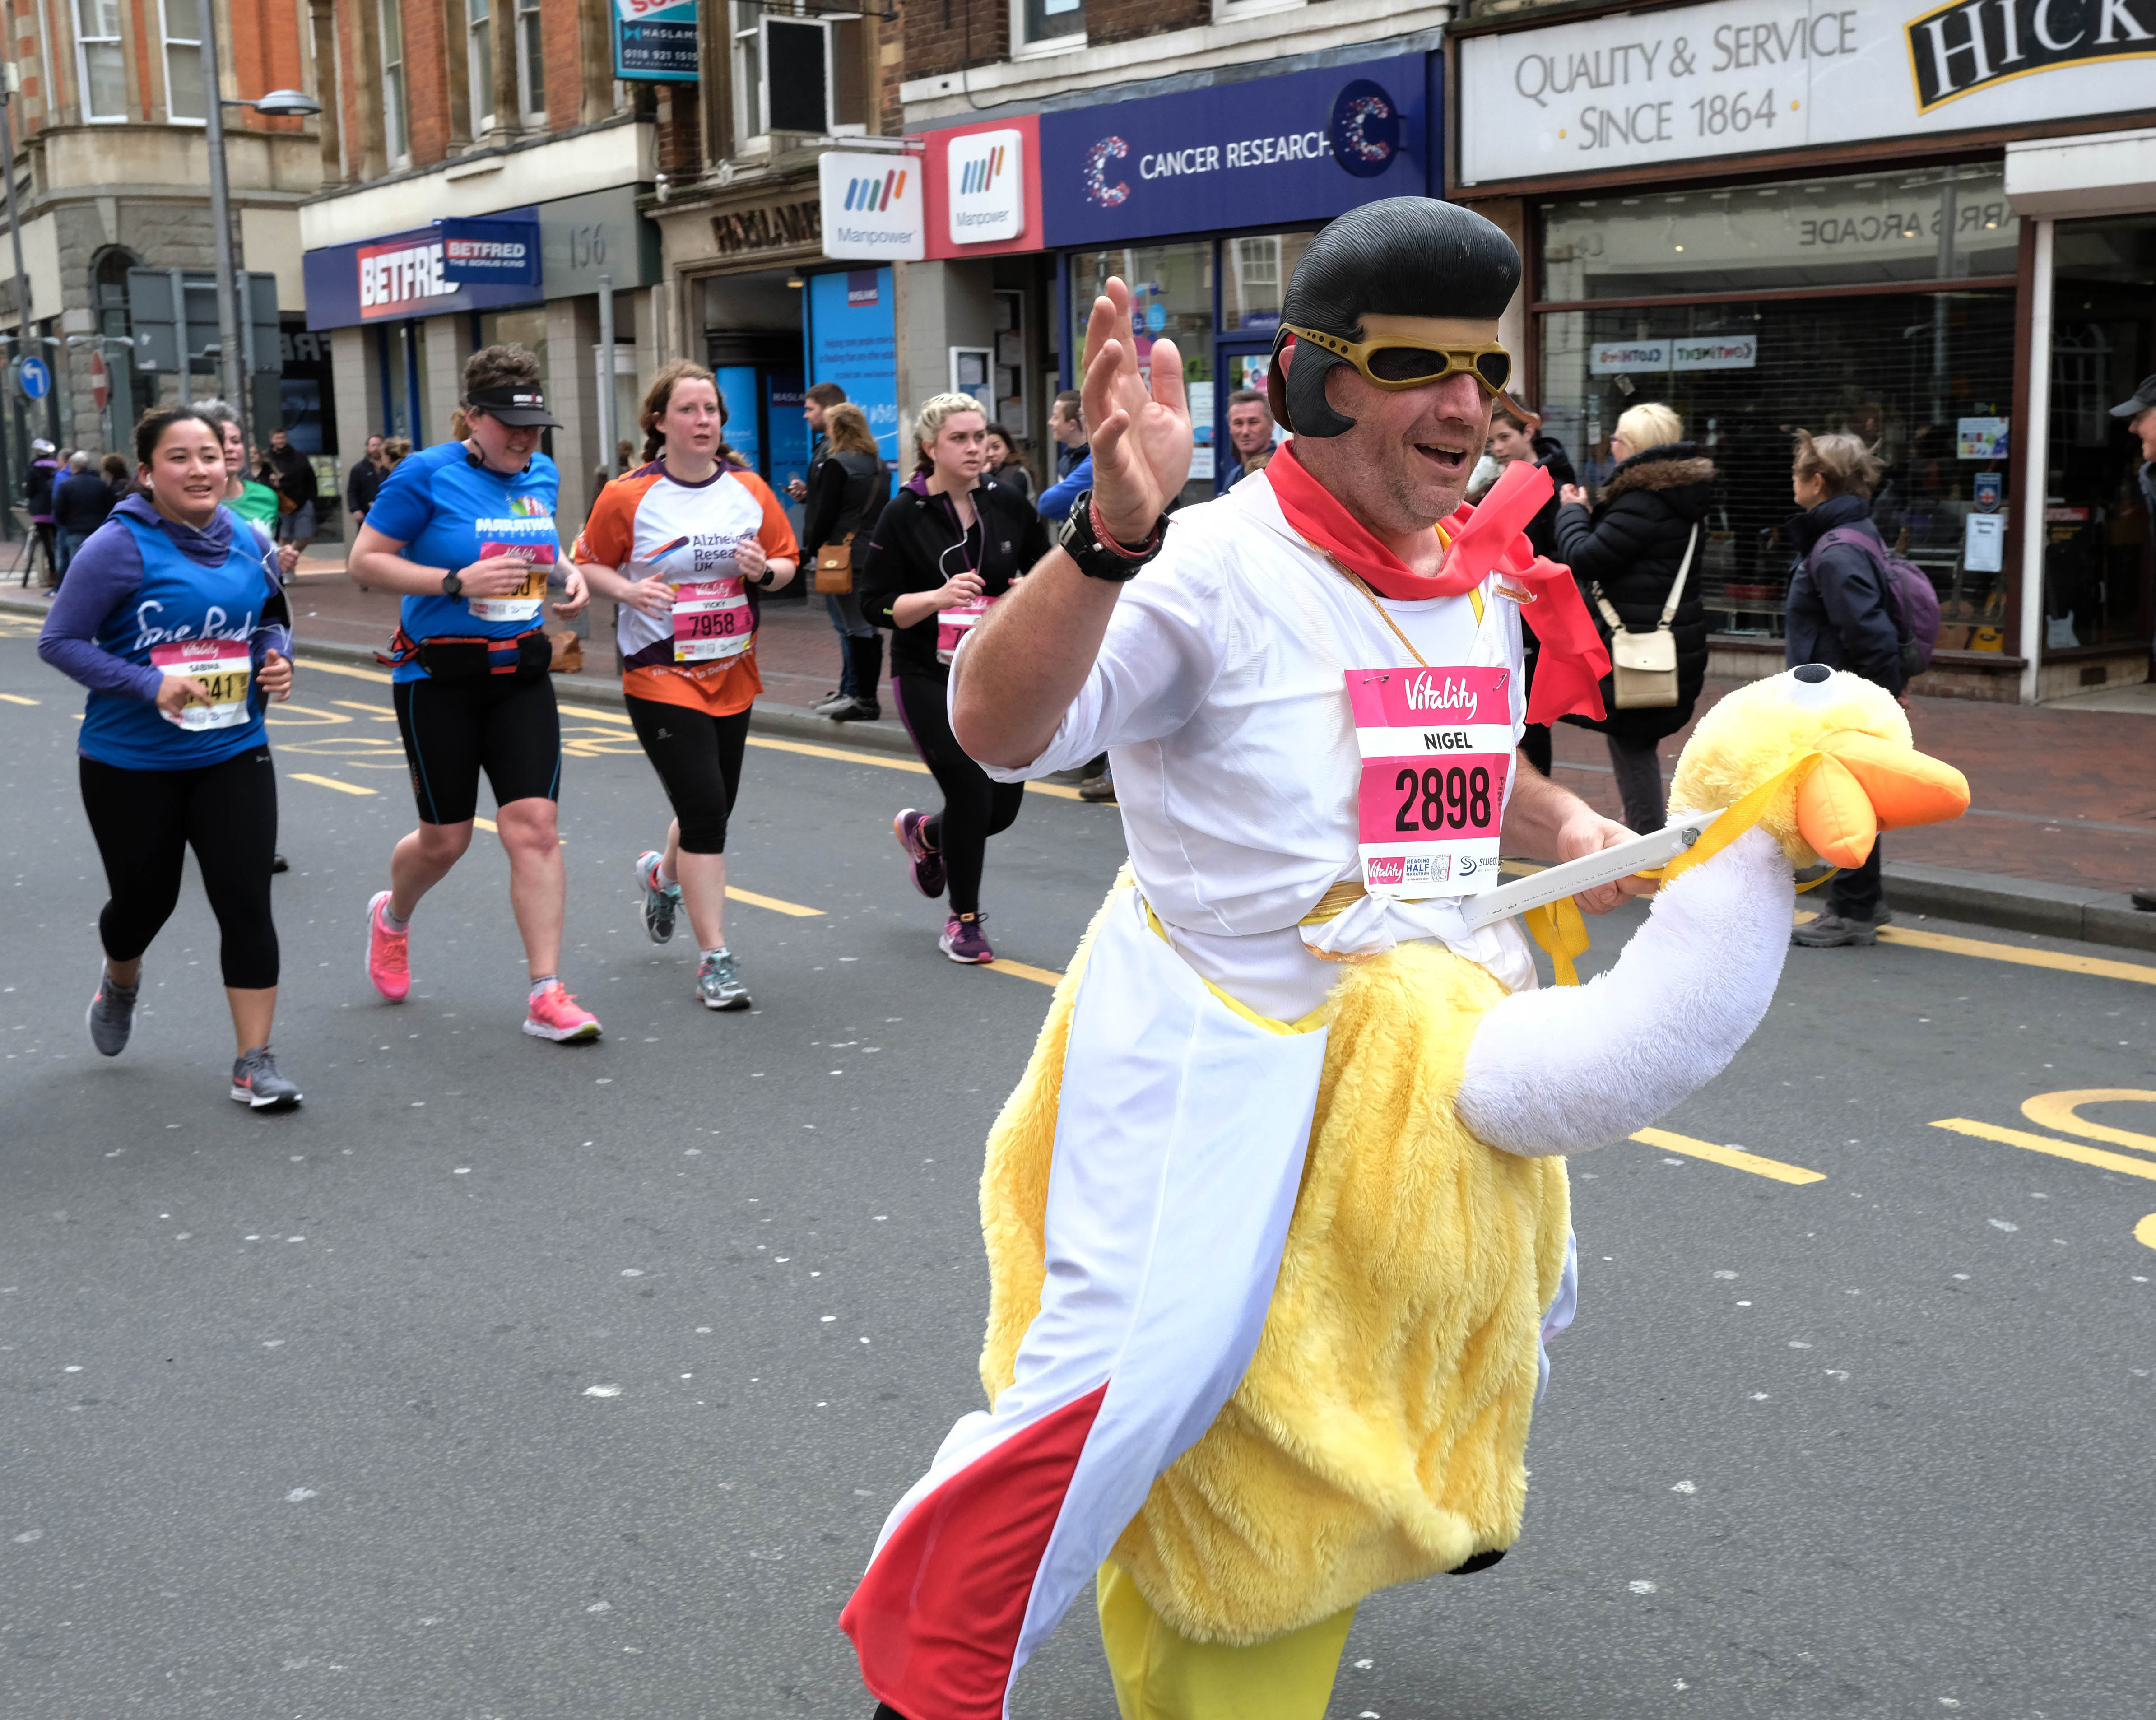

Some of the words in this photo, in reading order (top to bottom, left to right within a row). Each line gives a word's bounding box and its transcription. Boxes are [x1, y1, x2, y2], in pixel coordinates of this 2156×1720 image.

[624, 49, 650, 59] 0118
[652, 50, 672, 60] 921
[1515, 40, 1662, 108] QUALITY
[1669, 37, 1695, 78] &
[1712, 10, 1856, 72] SERVICE
[1579, 102, 1672, 149] SINCE
[1689, 89, 1775, 136] 1864
[1139, 146, 1220, 180] CANCER
[1226, 131, 1334, 168] RESEARCH
[956, 209, 1009, 228] Manpower
[569, 223, 607, 269] 156
[838, 227, 912, 245] Manpower
[449, 242, 526, 257] BETFRED
[361, 243, 460, 307] BETFRE
[694, 549, 737, 560] Resea
[694, 562, 713, 571] UK
[688, 613, 735, 637] 7958
[1405, 670, 1478, 721] Vitality
[1424, 732, 1473, 749] NIGEL
[1395, 766, 1491, 832] 2898
[1368, 860, 1403, 882] Vitality
[1407, 864, 1430, 872] HALF
